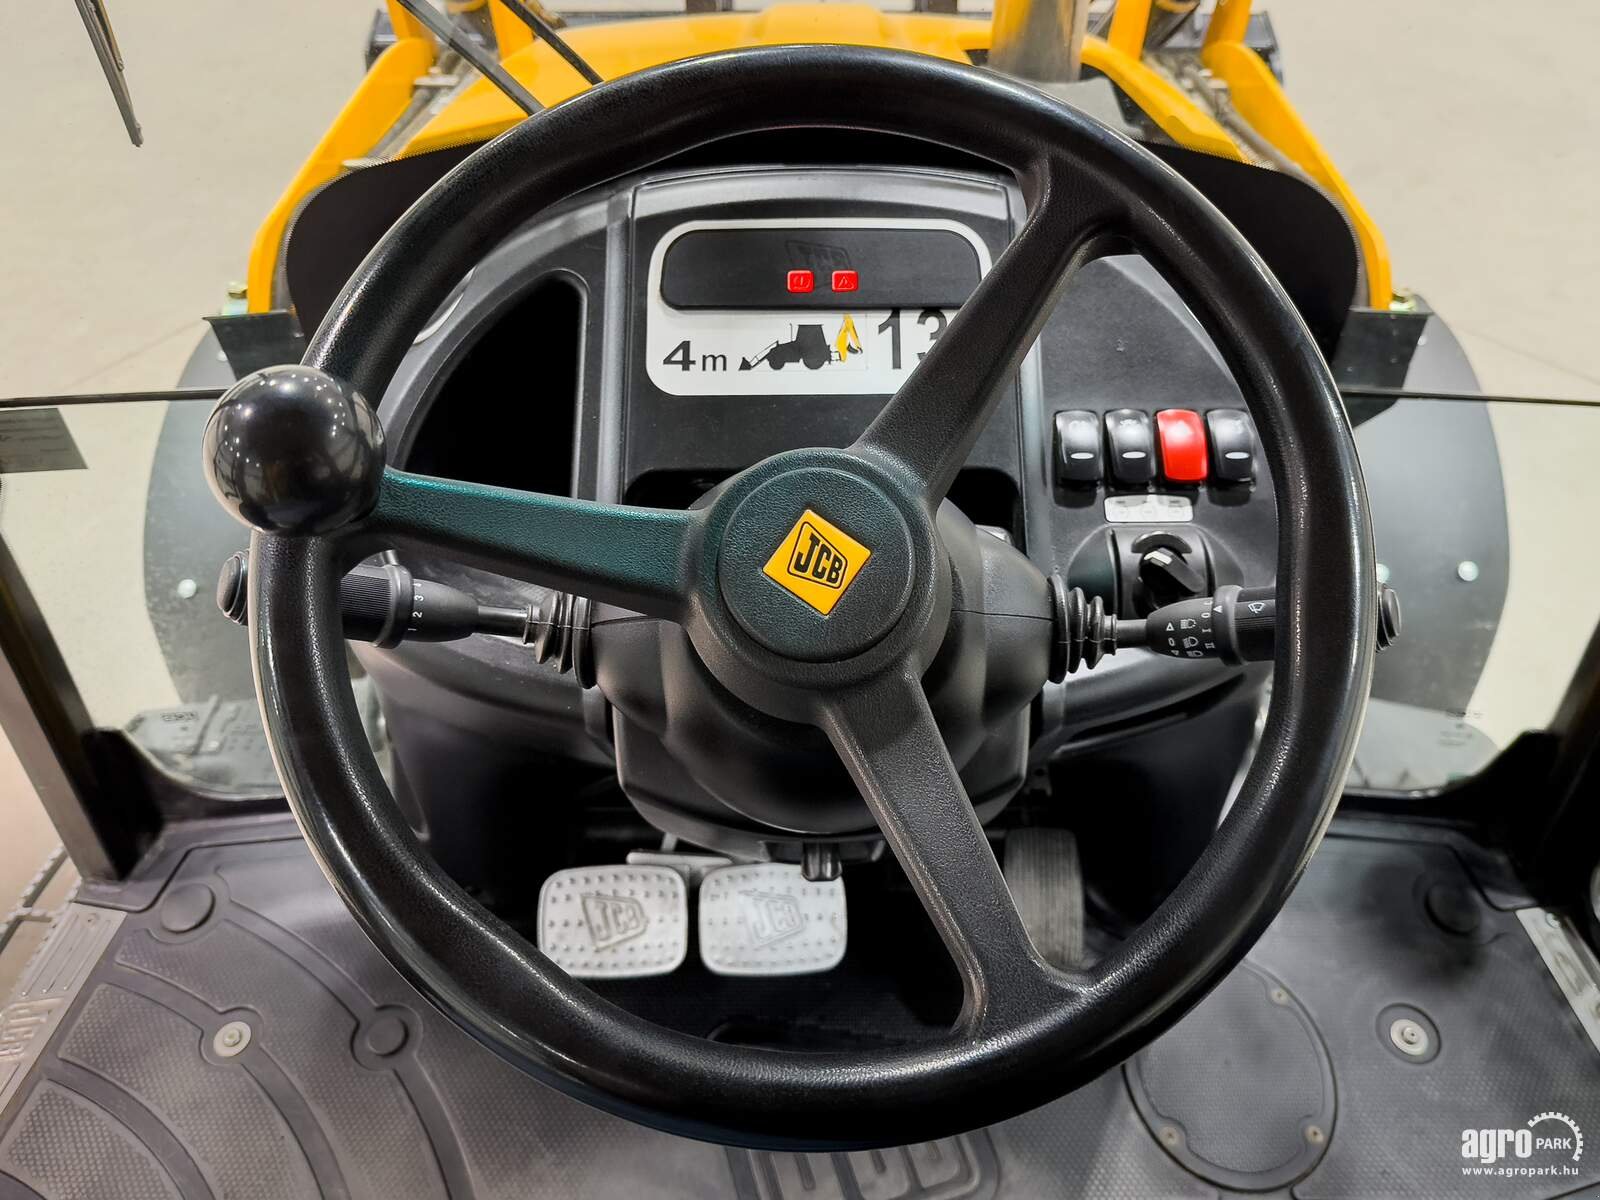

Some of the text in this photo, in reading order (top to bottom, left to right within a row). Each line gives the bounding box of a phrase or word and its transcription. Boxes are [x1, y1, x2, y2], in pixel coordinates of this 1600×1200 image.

[663, 340, 728, 372] 4 m
[793, 532, 844, 584] JCB
[593, 899, 642, 941] JCB
